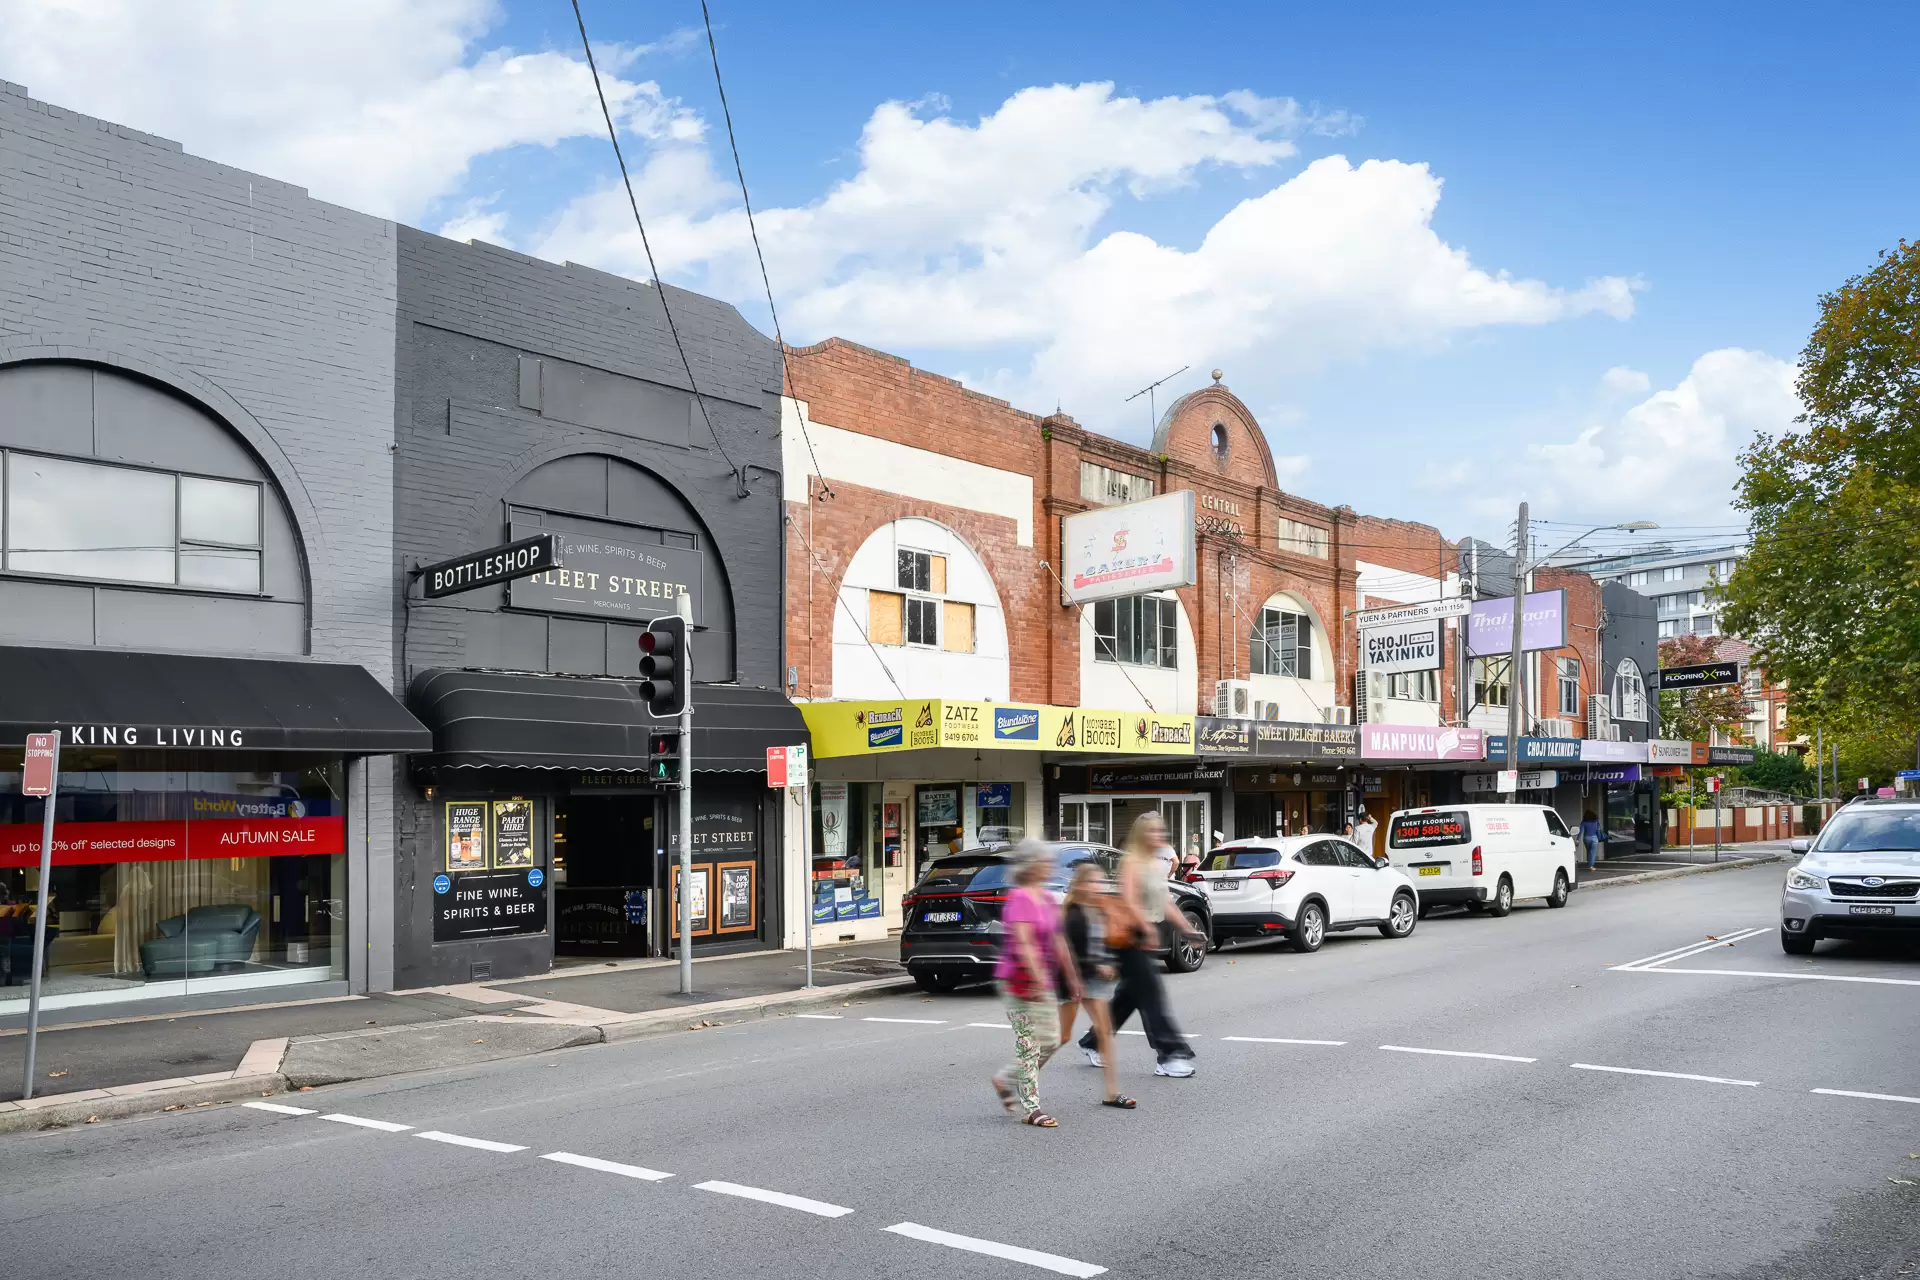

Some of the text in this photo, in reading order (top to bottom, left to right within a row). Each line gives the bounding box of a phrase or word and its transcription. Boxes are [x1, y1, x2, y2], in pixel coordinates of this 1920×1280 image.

[1202, 494, 1240, 517] CENTRAL
[576, 544, 602, 554] WINE,
[604, 545, 636, 560] SPIRITS
[646, 556, 668, 570] BEER
[434, 546, 540, 590] BOTTLESHOP
[531, 569, 688, 600] FLEET STREET
[594, 600, 631, 611] MERCHANTS
[1360, 614, 1379, 624] YUEN
[1388, 608, 1429, 619] PARTNERS
[1473, 612, 1508, 628] Thai
[1369, 634, 1408, 651] CHOJI
[1368, 644, 1435, 664] YAKINIKU
[945, 706, 978, 722] ZATZ
[997, 714, 1038, 729] Blundstone
[1086, 718, 1116, 730] MONGREL
[72, 726, 243, 747] KING LIVING
[870, 728, 902, 742] Blundstone
[913, 736, 934, 744] BOOTS
[945, 732, 978, 742] 9419 6704
[1086, 732, 1116, 746] BOOTS
[1258, 724, 1357, 745] SWEET DELIGHT BAKERY
[1372, 731, 1435, 752] MANPUKU
[36, 738, 46, 747] NO
[28, 748, 54, 758] STOPPING
[1322, 746, 1336, 754] Phone:
[1527, 742, 1546, 757] CHOJI
[1548, 742, 1575, 758] YAKINIKU
[1658, 748, 1680, 757] SUNFLOWER
[582, 776, 652, 784] FLEET STREE
[1164, 772, 1192, 780] DELIGHT
[1194, 770, 1224, 779] BAKERY
[1560, 770, 1625, 782] Thai Naan
[1478, 780, 1540, 790] YAIKU
[502, 816, 526, 824] PARTY
[220, 830, 316, 845] AUTUMN SALE
[712, 832, 754, 843] STREET
[1397, 824, 1462, 838] 1300 588 550
[12, 844, 26, 853] up
[30, 842, 41, 851] to
[51, 841, 69, 850] 0%
[90, 838, 134, 849] selected
[136, 838, 176, 848] designs
[456, 888, 523, 901] FINE WINE,
[444, 903, 535, 920] SPIRITS & BEER
